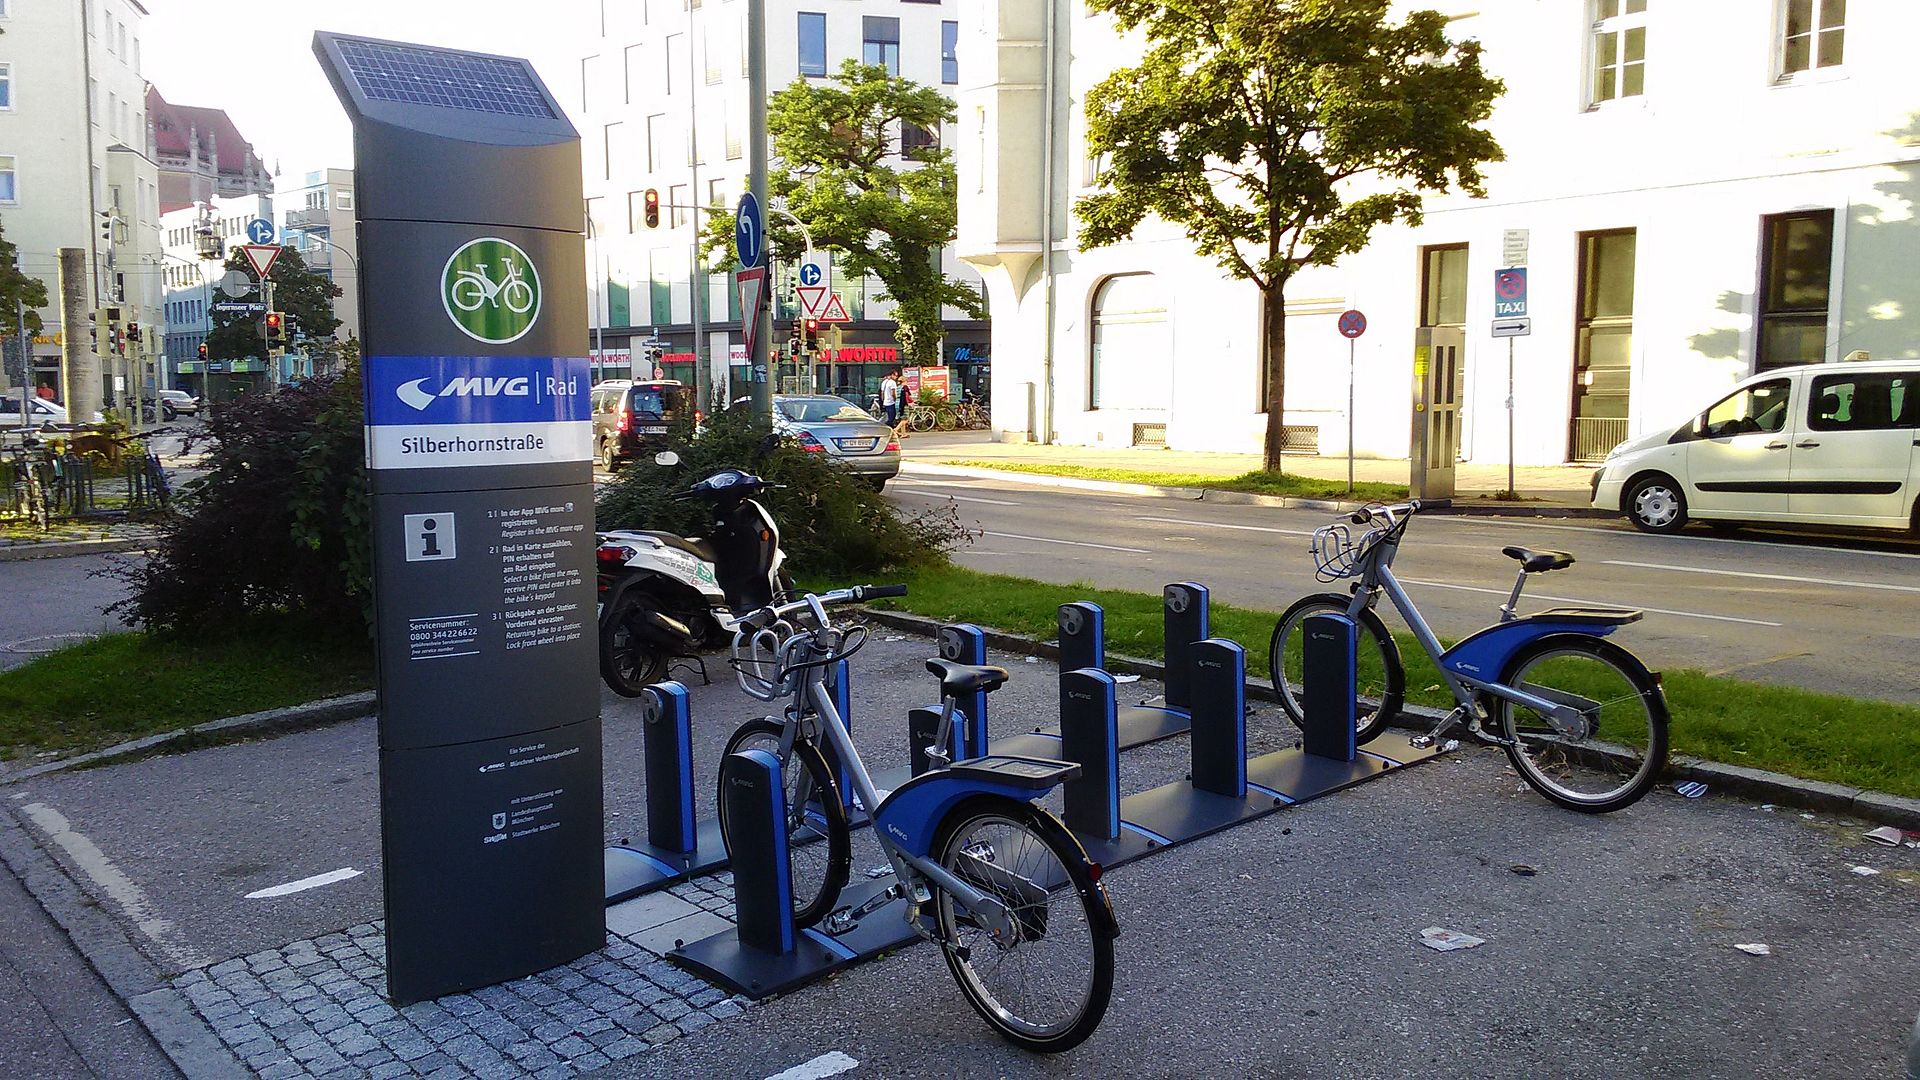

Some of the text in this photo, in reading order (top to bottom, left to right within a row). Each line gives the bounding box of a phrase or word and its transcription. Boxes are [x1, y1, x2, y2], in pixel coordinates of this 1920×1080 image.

[1497, 301, 1525, 314] TAXI
[438, 375, 577, 397] MVG Rad
[401, 434, 544, 454] Silberhornstraße
[509, 509, 520, 517] der
[521, 508, 534, 516] App
[535, 506, 549, 514] MVG
[502, 519, 537, 528] registrieren
[502, 530, 527, 538] Register
[516, 553, 541, 561] erhalten
[515, 564, 528, 572] Rad
[529, 562, 556, 571] eingeben
[504, 575, 522, 583] Select
[542, 572, 556, 580] from
[504, 585, 526, 594] receive
[527, 583, 538, 591] PIN
[539, 582, 550, 590] and
[551, 580, 565, 588] enter
[504, 596, 515, 604] the
[535, 591, 556, 600] keypad
[505, 609, 535, 619] Rückgabe
[546, 606, 555, 614] der
[409, 620, 469, 631] Servicenummer:
[505, 616, 564, 628] Vorderrad einrasten
[410, 632, 430, 640] 0800
[506, 629, 536, 639] Returning
[537, 627, 549, 635] bike
[506, 642, 521, 650] Lock
[522, 640, 536, 648] front
[538, 636, 554, 645] wheel
[567, 632, 580, 641] place
[519, 745, 536, 753] Service
